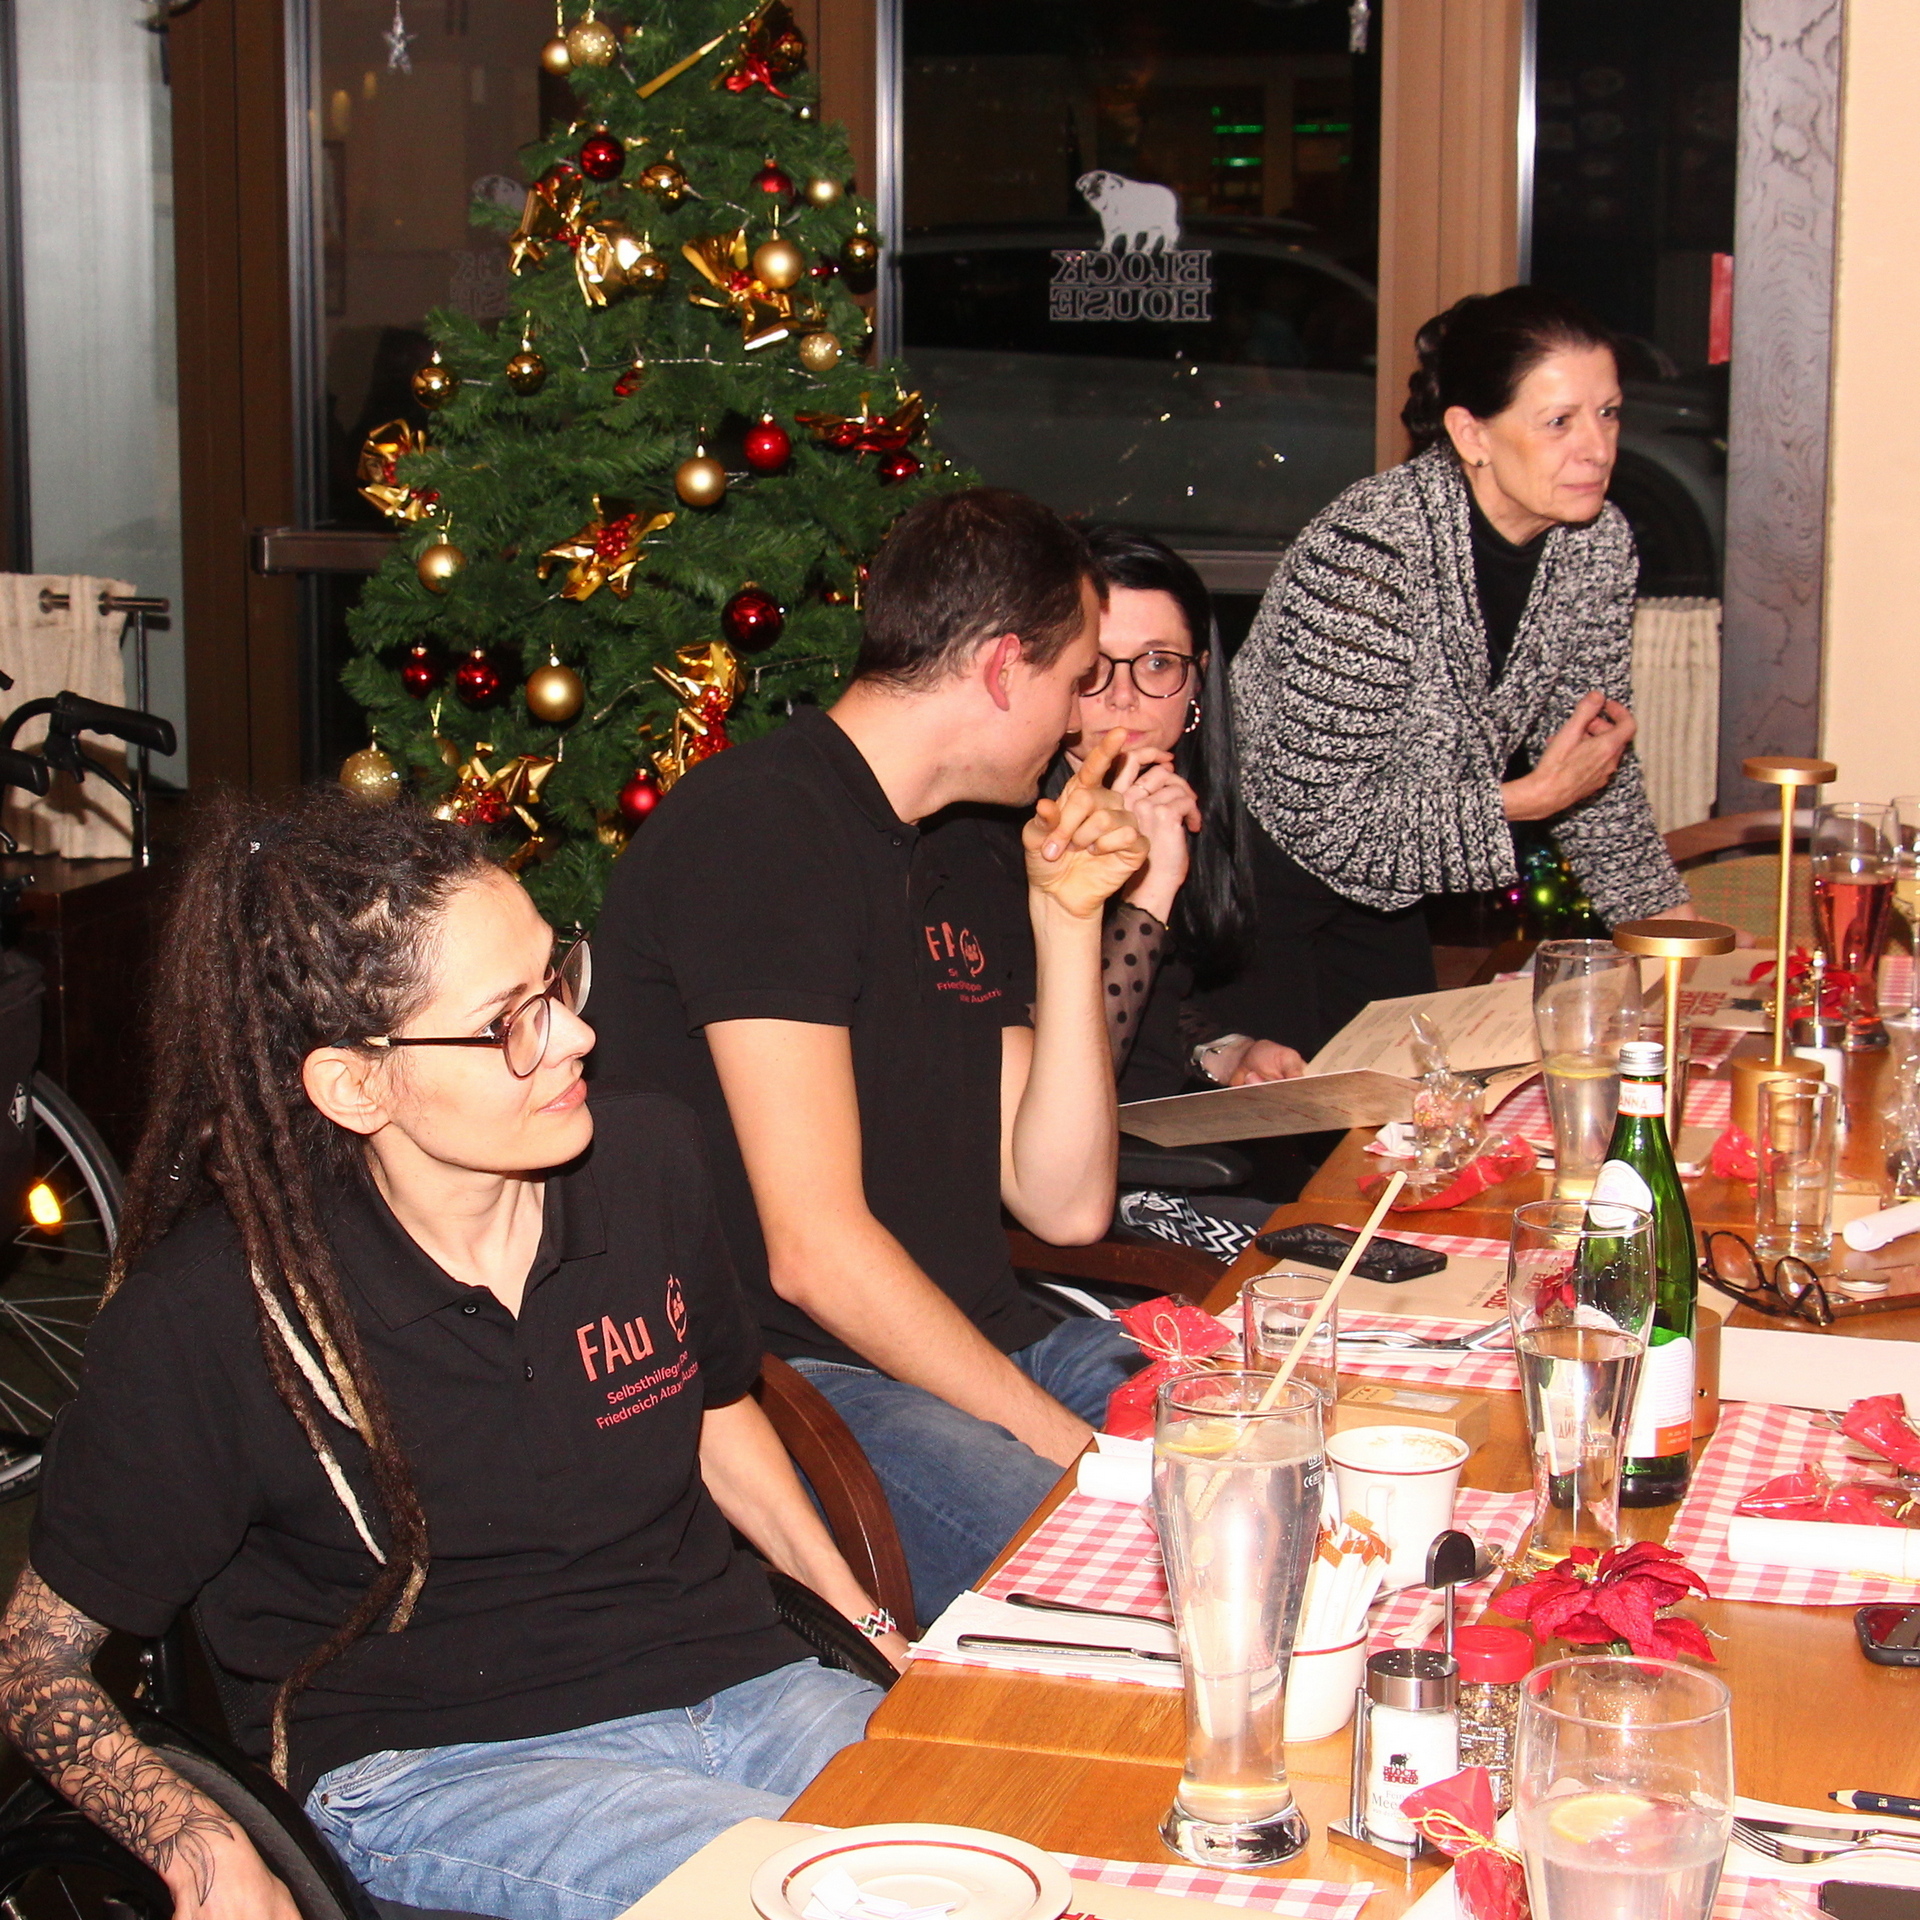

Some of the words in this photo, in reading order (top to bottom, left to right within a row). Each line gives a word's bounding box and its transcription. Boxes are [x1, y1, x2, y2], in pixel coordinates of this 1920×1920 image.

[576, 1315, 655, 1382] FAu
[606, 1350, 689, 1405] Selbsthilfegrpe
[596, 1393, 659, 1430] Friedreich
[1383, 1766, 1418, 1777] BLOCK
[1383, 1774, 1419, 1785] HOUSE
